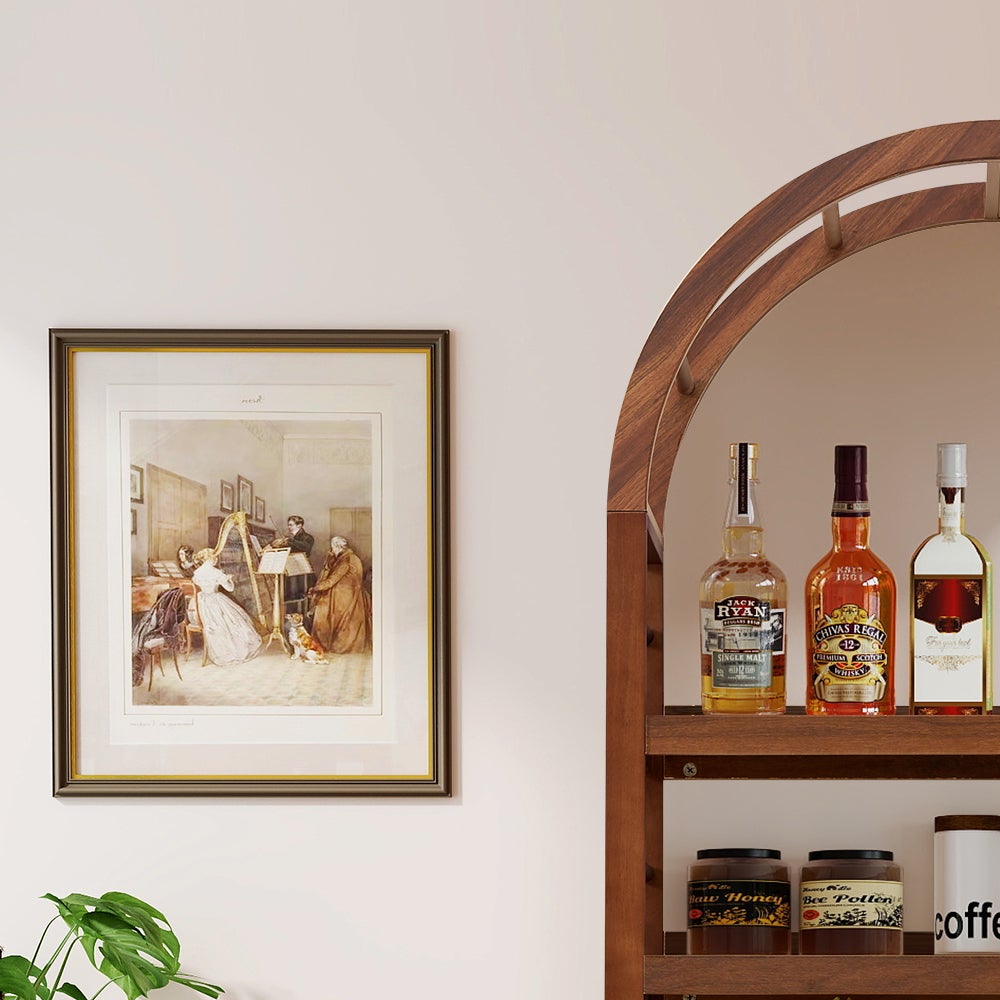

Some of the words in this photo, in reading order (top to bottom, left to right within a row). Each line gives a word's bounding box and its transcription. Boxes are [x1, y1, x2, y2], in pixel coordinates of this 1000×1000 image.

[717, 606, 768, 617] RYAN
[815, 624, 850, 642] CHIVAS
[853, 625, 884, 643] REGAL
[844, 640, 854, 650] 12
[717, 654, 743, 662] SINGLE
[746, 653, 767, 662] MALT
[816, 653, 846, 661] PREMIUM
[855, 653, 883, 661] SCOTCH
[724, 892, 783, 905] Honey
[802, 895, 828, 904] Bee
[832, 893, 893, 904] Pollen
